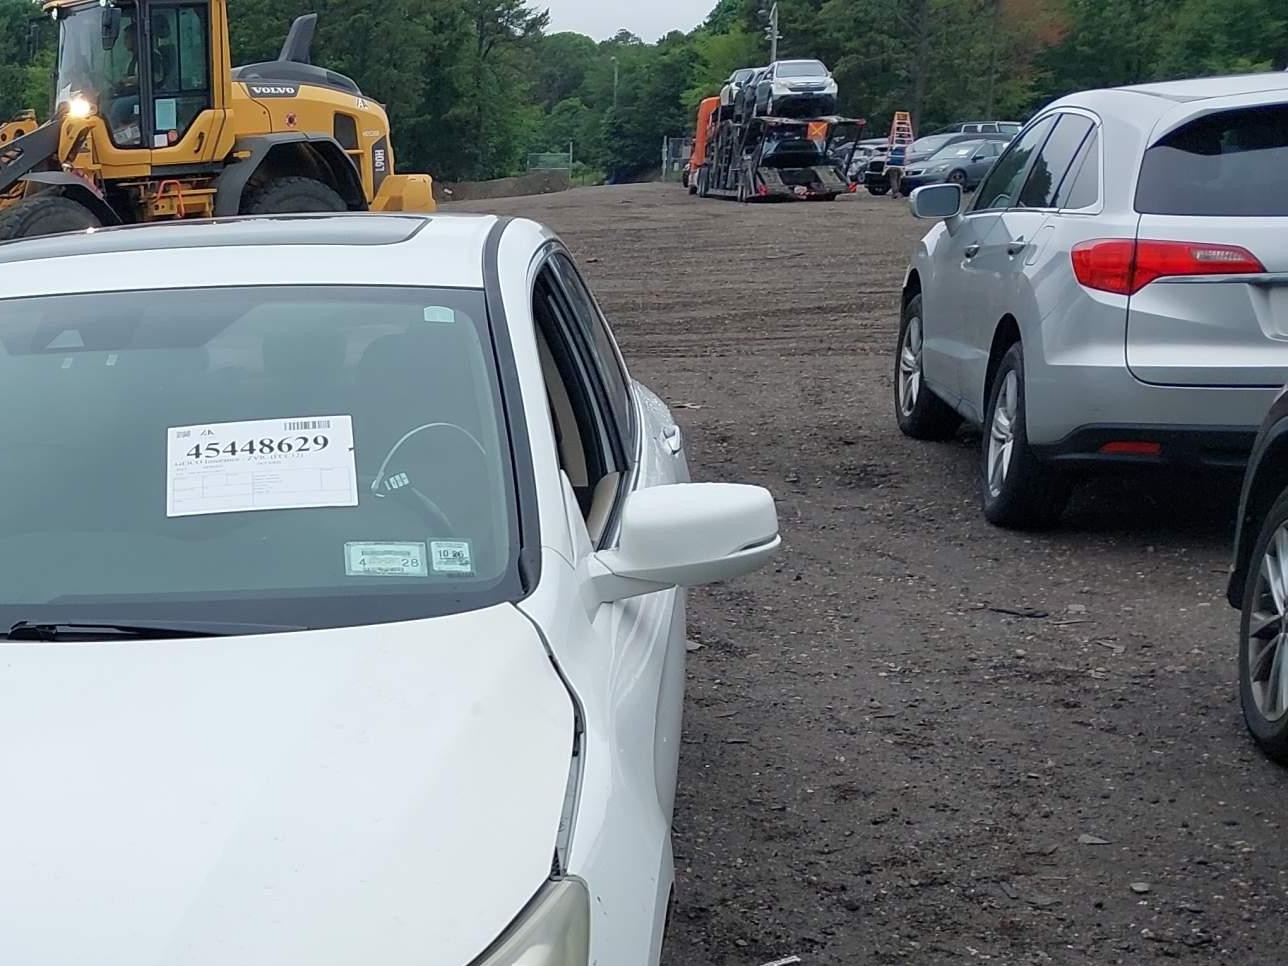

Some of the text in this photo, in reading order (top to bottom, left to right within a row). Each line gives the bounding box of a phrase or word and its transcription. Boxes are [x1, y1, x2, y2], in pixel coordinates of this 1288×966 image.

[251, 86, 295, 94] VOLVO
[374, 149, 385, 172] L90H
[186, 434, 330, 460] 45448629
[359, 558, 419, 568] 4 28
